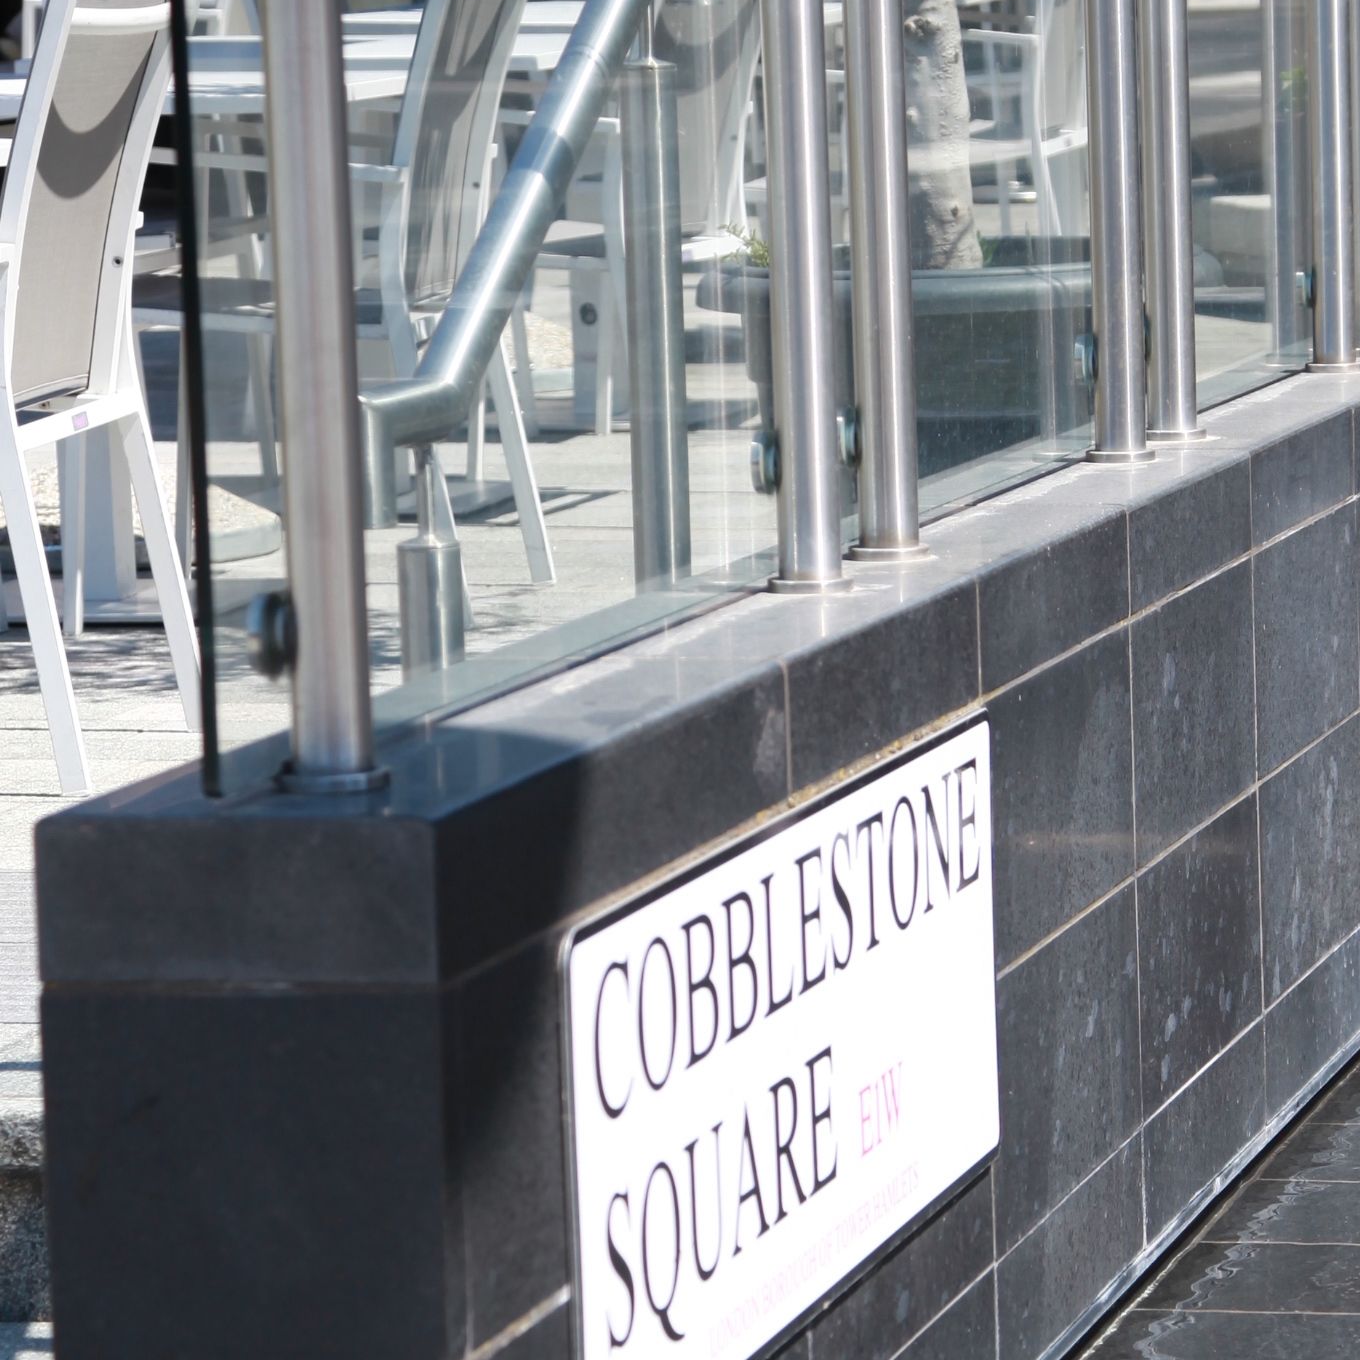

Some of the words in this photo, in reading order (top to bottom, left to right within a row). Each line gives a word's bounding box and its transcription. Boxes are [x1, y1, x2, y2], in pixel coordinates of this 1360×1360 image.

[594, 757, 981, 1120] COBBLESTONE
[606, 1044, 839, 1354] SQUARE
[858, 1061, 904, 1159] E1W
[709, 1294, 761, 1359] LONDON
[761, 1241, 818, 1316] BOROUGH
[834, 1198, 872, 1253] TOWER
[871, 1161, 920, 1222] HAMLETS
